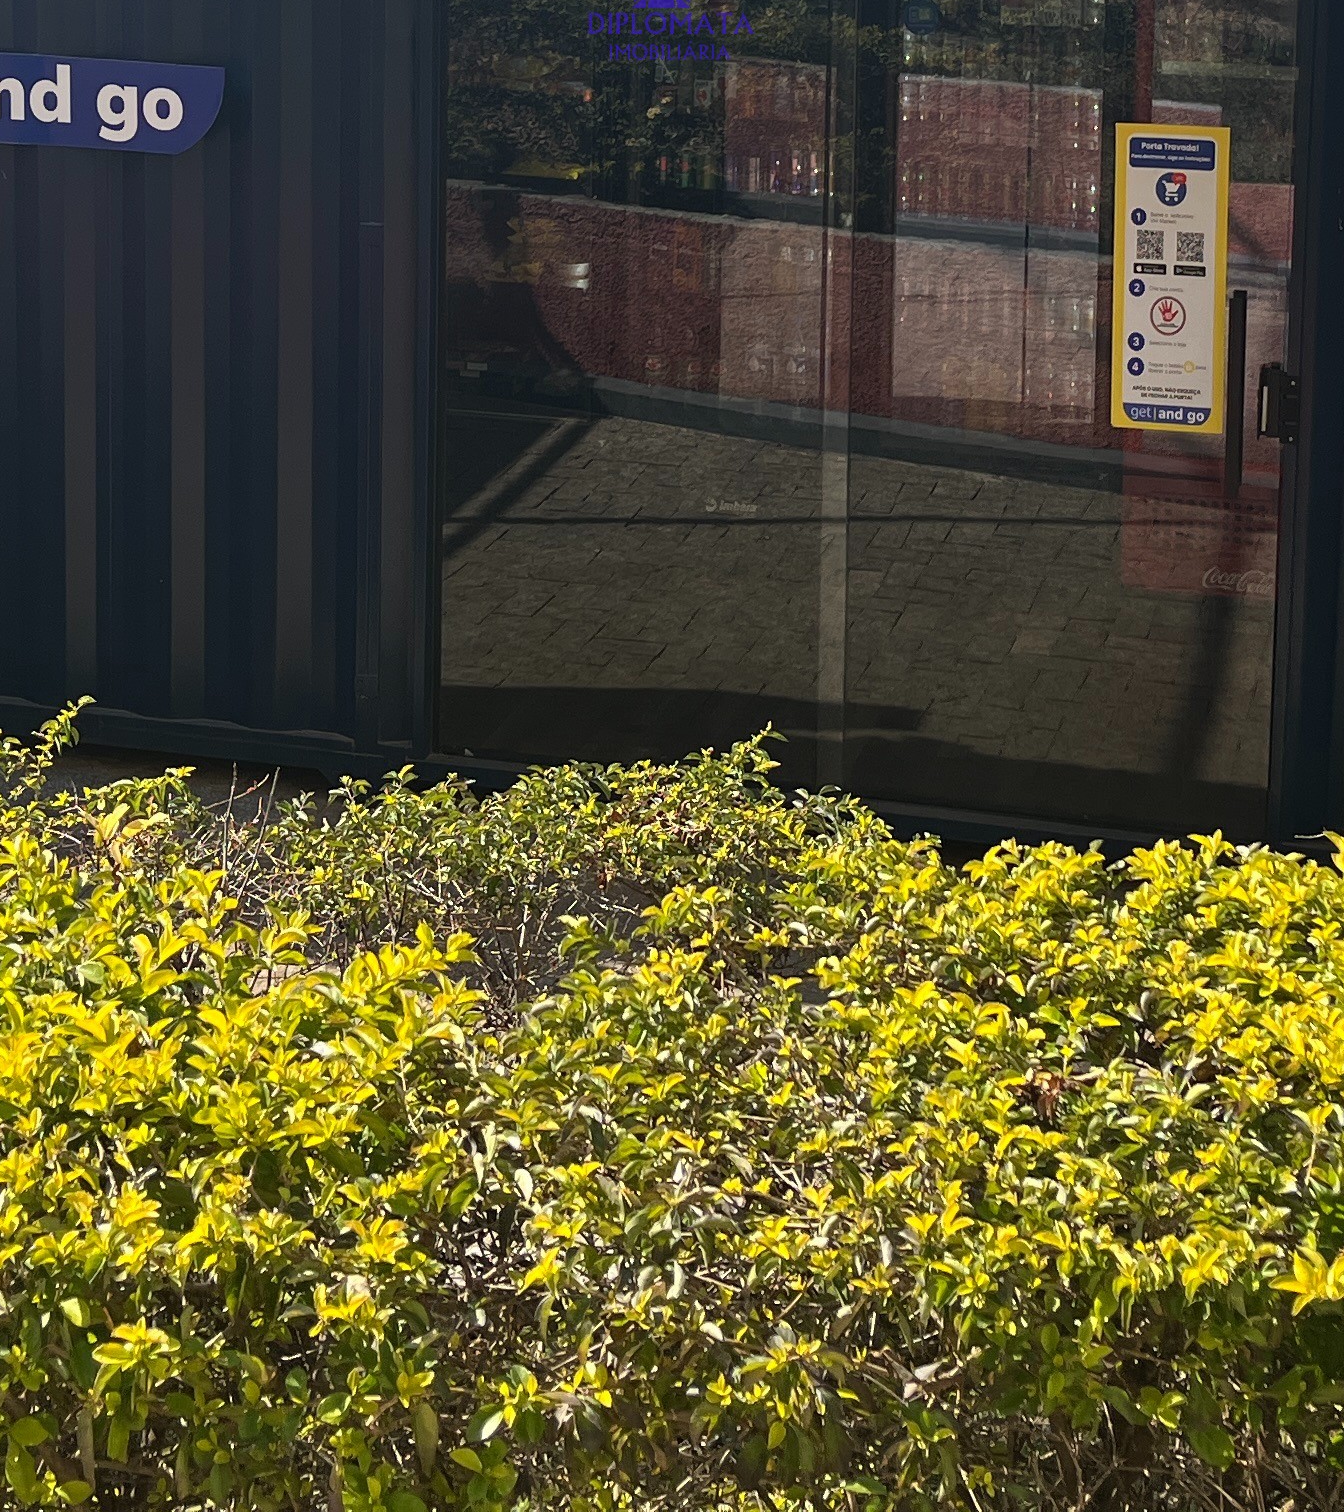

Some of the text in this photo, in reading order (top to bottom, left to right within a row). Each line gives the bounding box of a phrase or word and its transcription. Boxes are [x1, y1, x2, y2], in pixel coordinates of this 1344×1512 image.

[96, 82, 184, 143] go
[1141, 142, 1163, 150] Porta
[1136, 212, 1141, 222] 1
[1133, 283, 1140, 292] 2
[1132, 337, 1140, 347] 3
[1131, 362, 1139, 371] 4
[1130, 406, 1205, 424] get and go
